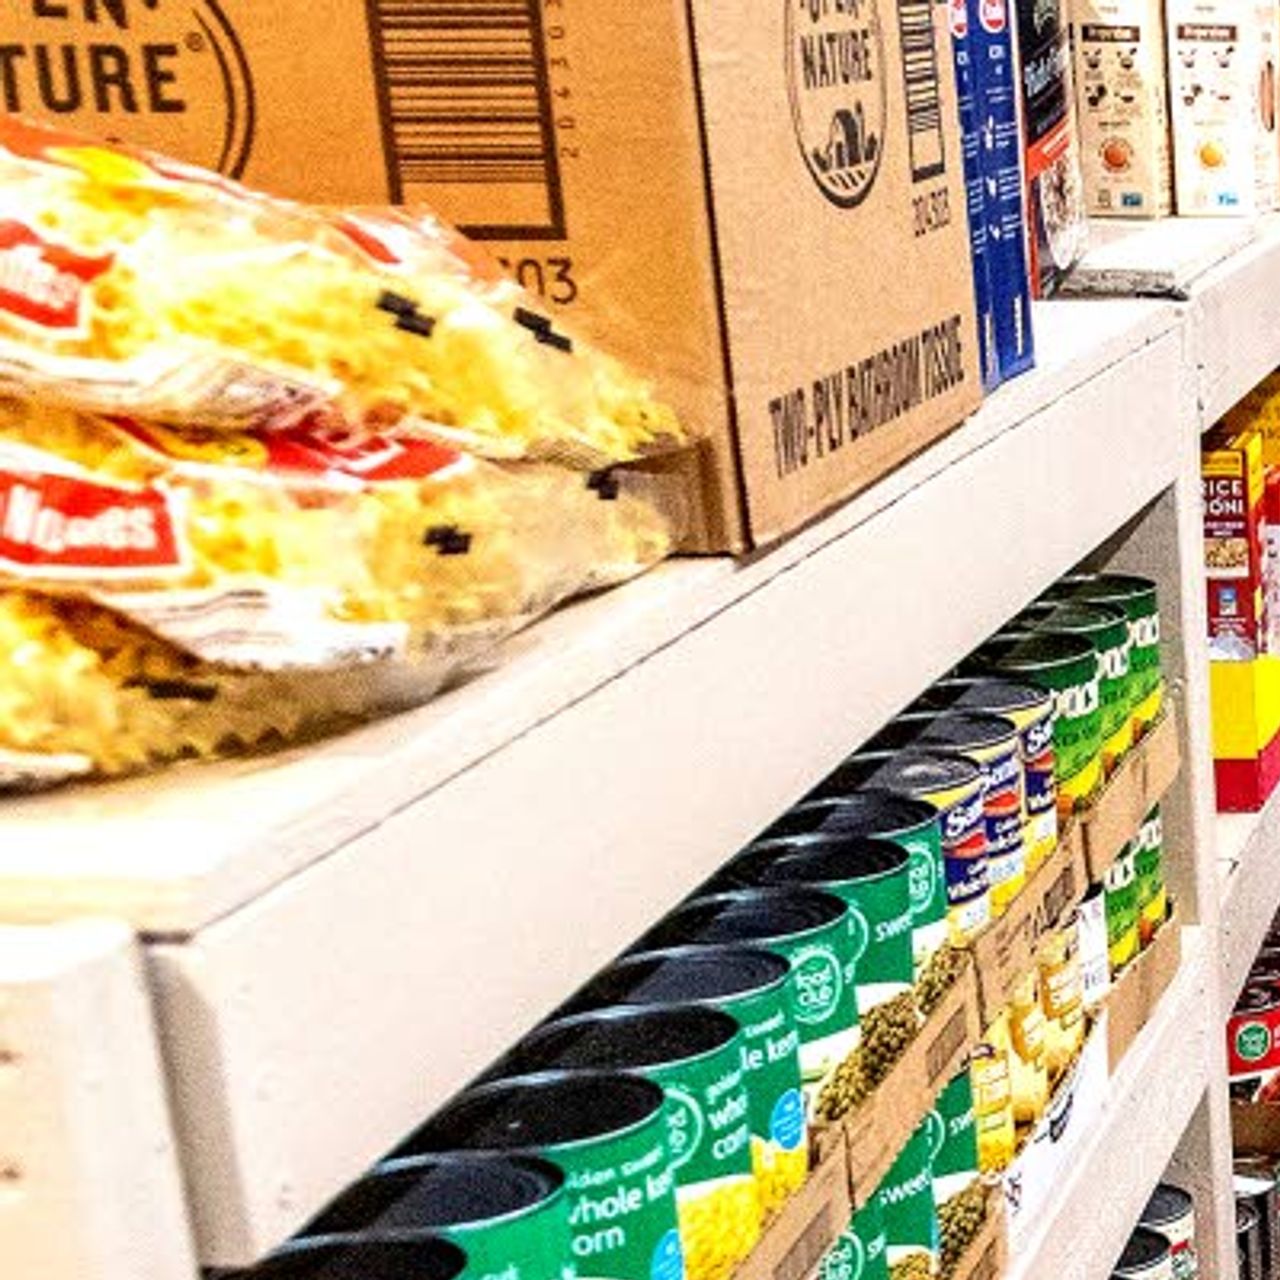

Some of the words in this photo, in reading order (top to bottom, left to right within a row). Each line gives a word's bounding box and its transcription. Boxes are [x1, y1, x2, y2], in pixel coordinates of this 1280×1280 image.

[801, 31, 872, 88] NATURE
[502, 257, 578, 304] 03
[769, 368, 843, 476] TWO-PLY
[847, 341, 922, 443] BATHROOM
[923, 315, 966, 405] TISSUE
